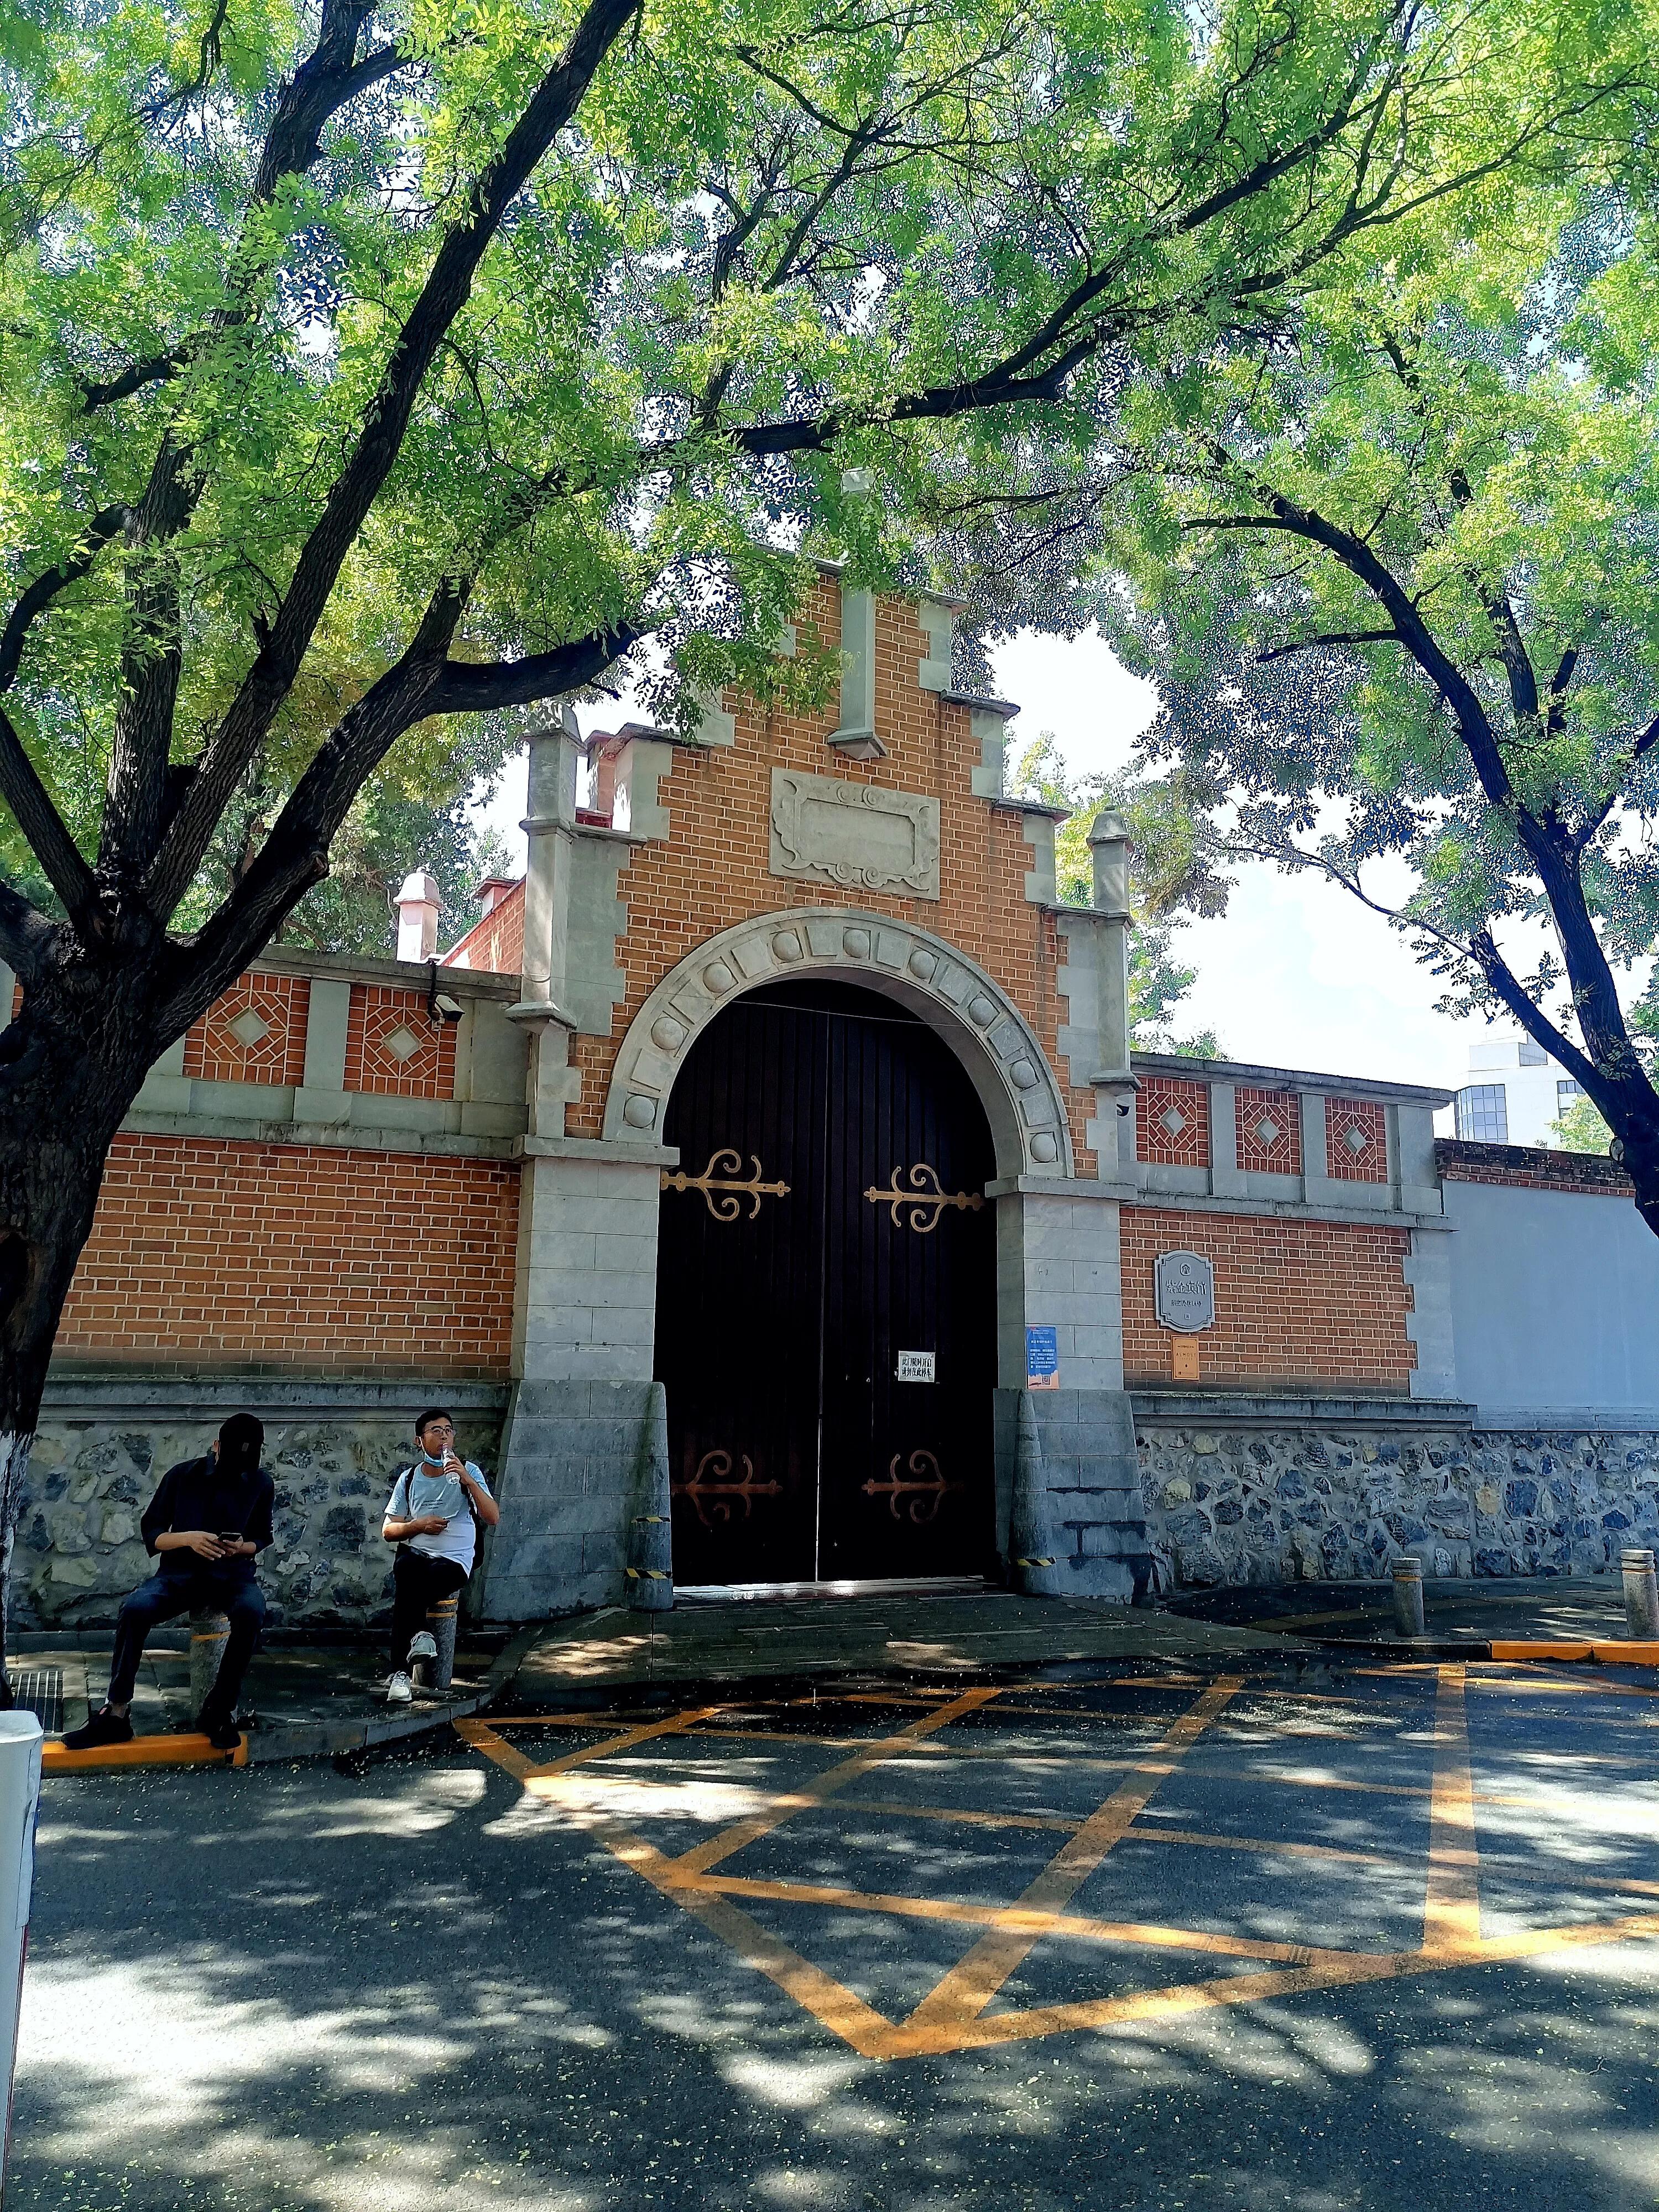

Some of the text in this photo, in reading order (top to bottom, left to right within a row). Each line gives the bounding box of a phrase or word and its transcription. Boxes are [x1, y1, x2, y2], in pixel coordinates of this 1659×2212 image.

[1165, 1280, 1207, 1295] 紫金宾馆
[902, 1357, 932, 1367] 此门随时开启
[902, 1366, 932, 1378] 请勿在此停车
